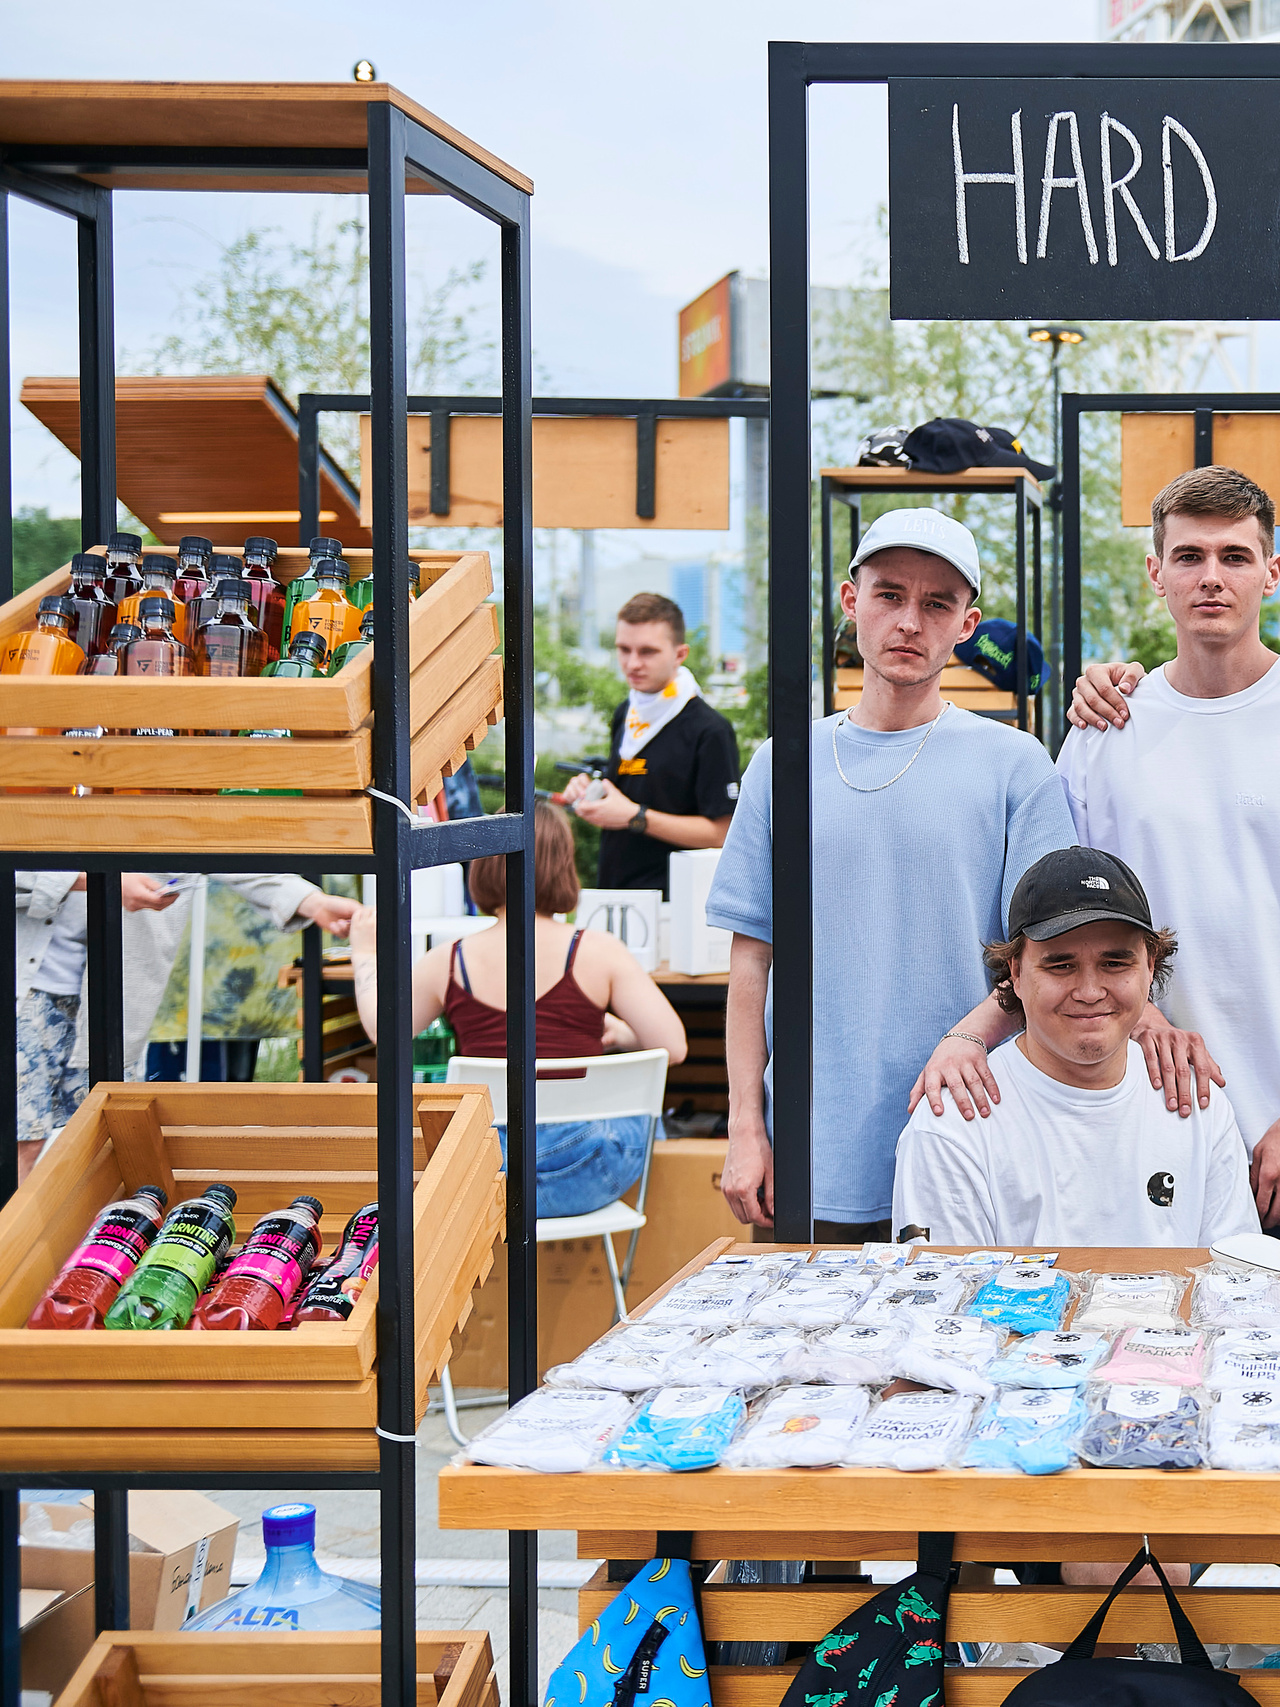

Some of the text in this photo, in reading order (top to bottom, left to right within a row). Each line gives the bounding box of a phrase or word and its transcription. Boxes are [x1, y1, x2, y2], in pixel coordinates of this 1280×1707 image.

[953, 103, 1218, 266] HARD
[903, 518, 946, 540] LEVI'S
[136, 728, 174, 737] APPLE-PEAR
[1241, 1370, 1276, 1381] НЕРВ
[213, 1606, 299, 1631] ALTA
[638, 1660, 650, 1690] SUPER
